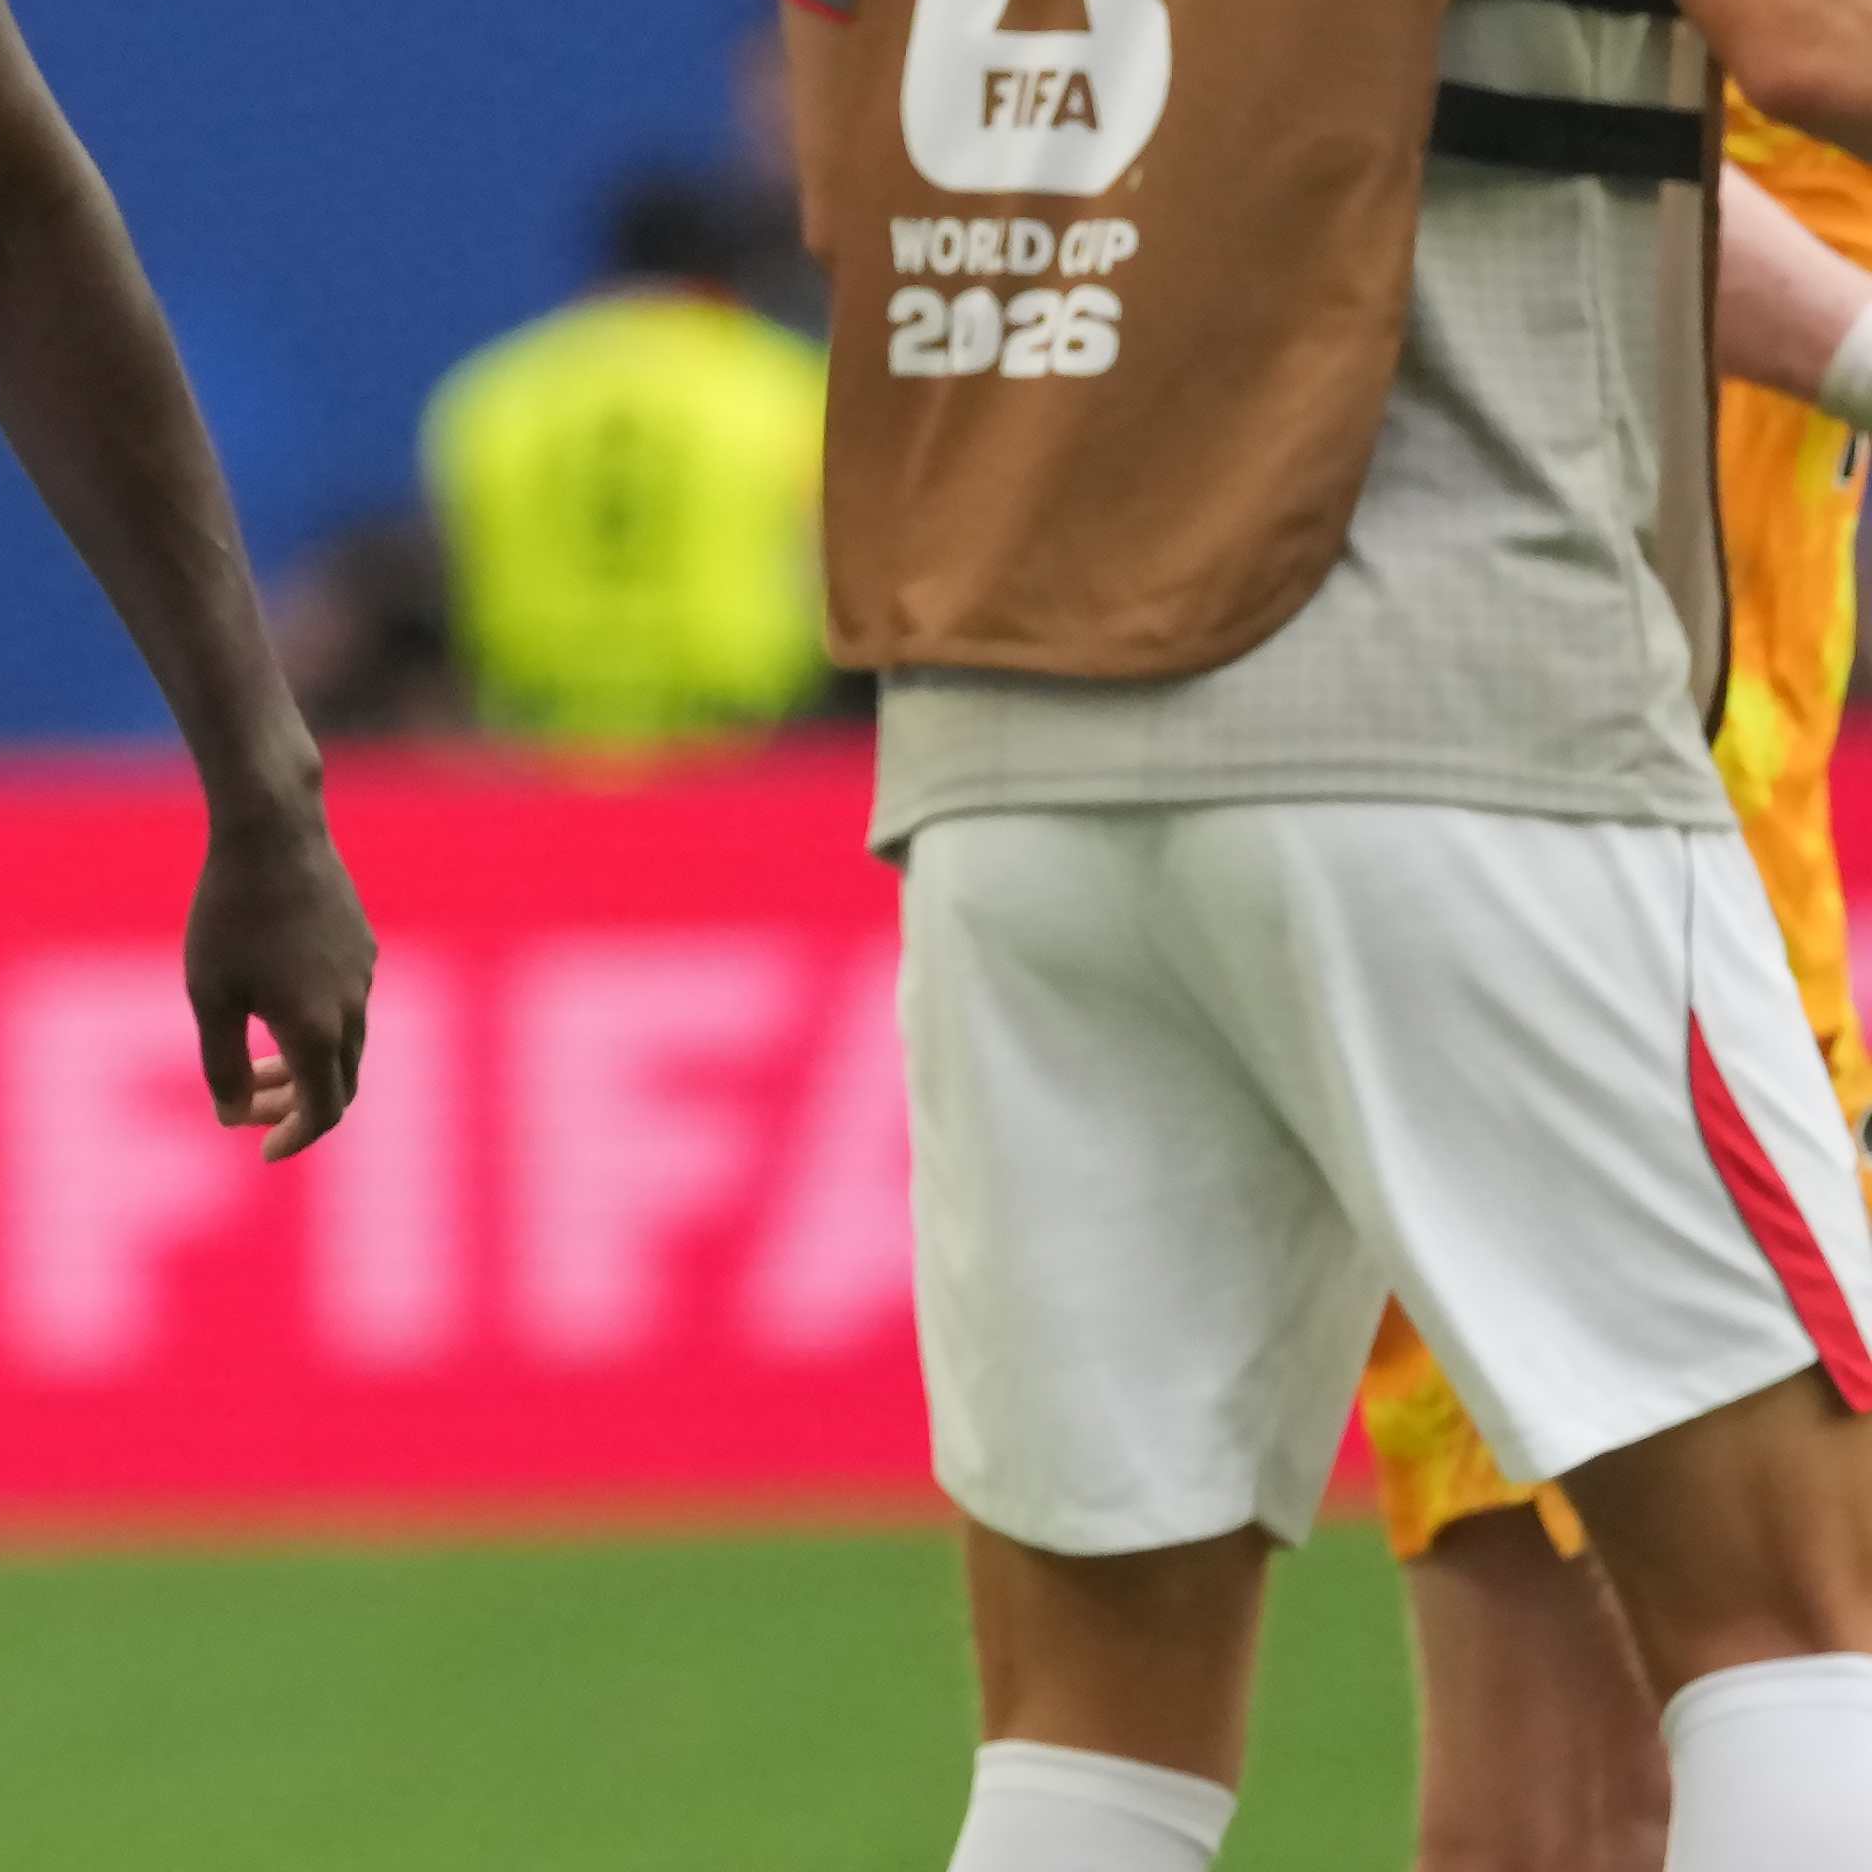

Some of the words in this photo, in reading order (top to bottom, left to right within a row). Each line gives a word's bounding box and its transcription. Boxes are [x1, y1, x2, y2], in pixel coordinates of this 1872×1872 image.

[981, 69, 1099, 131] FIFA
[889, 216, 1055, 276] WORLD
[1057, 216, 1139, 278] CUP
[887, 282, 1123, 379] 2026
